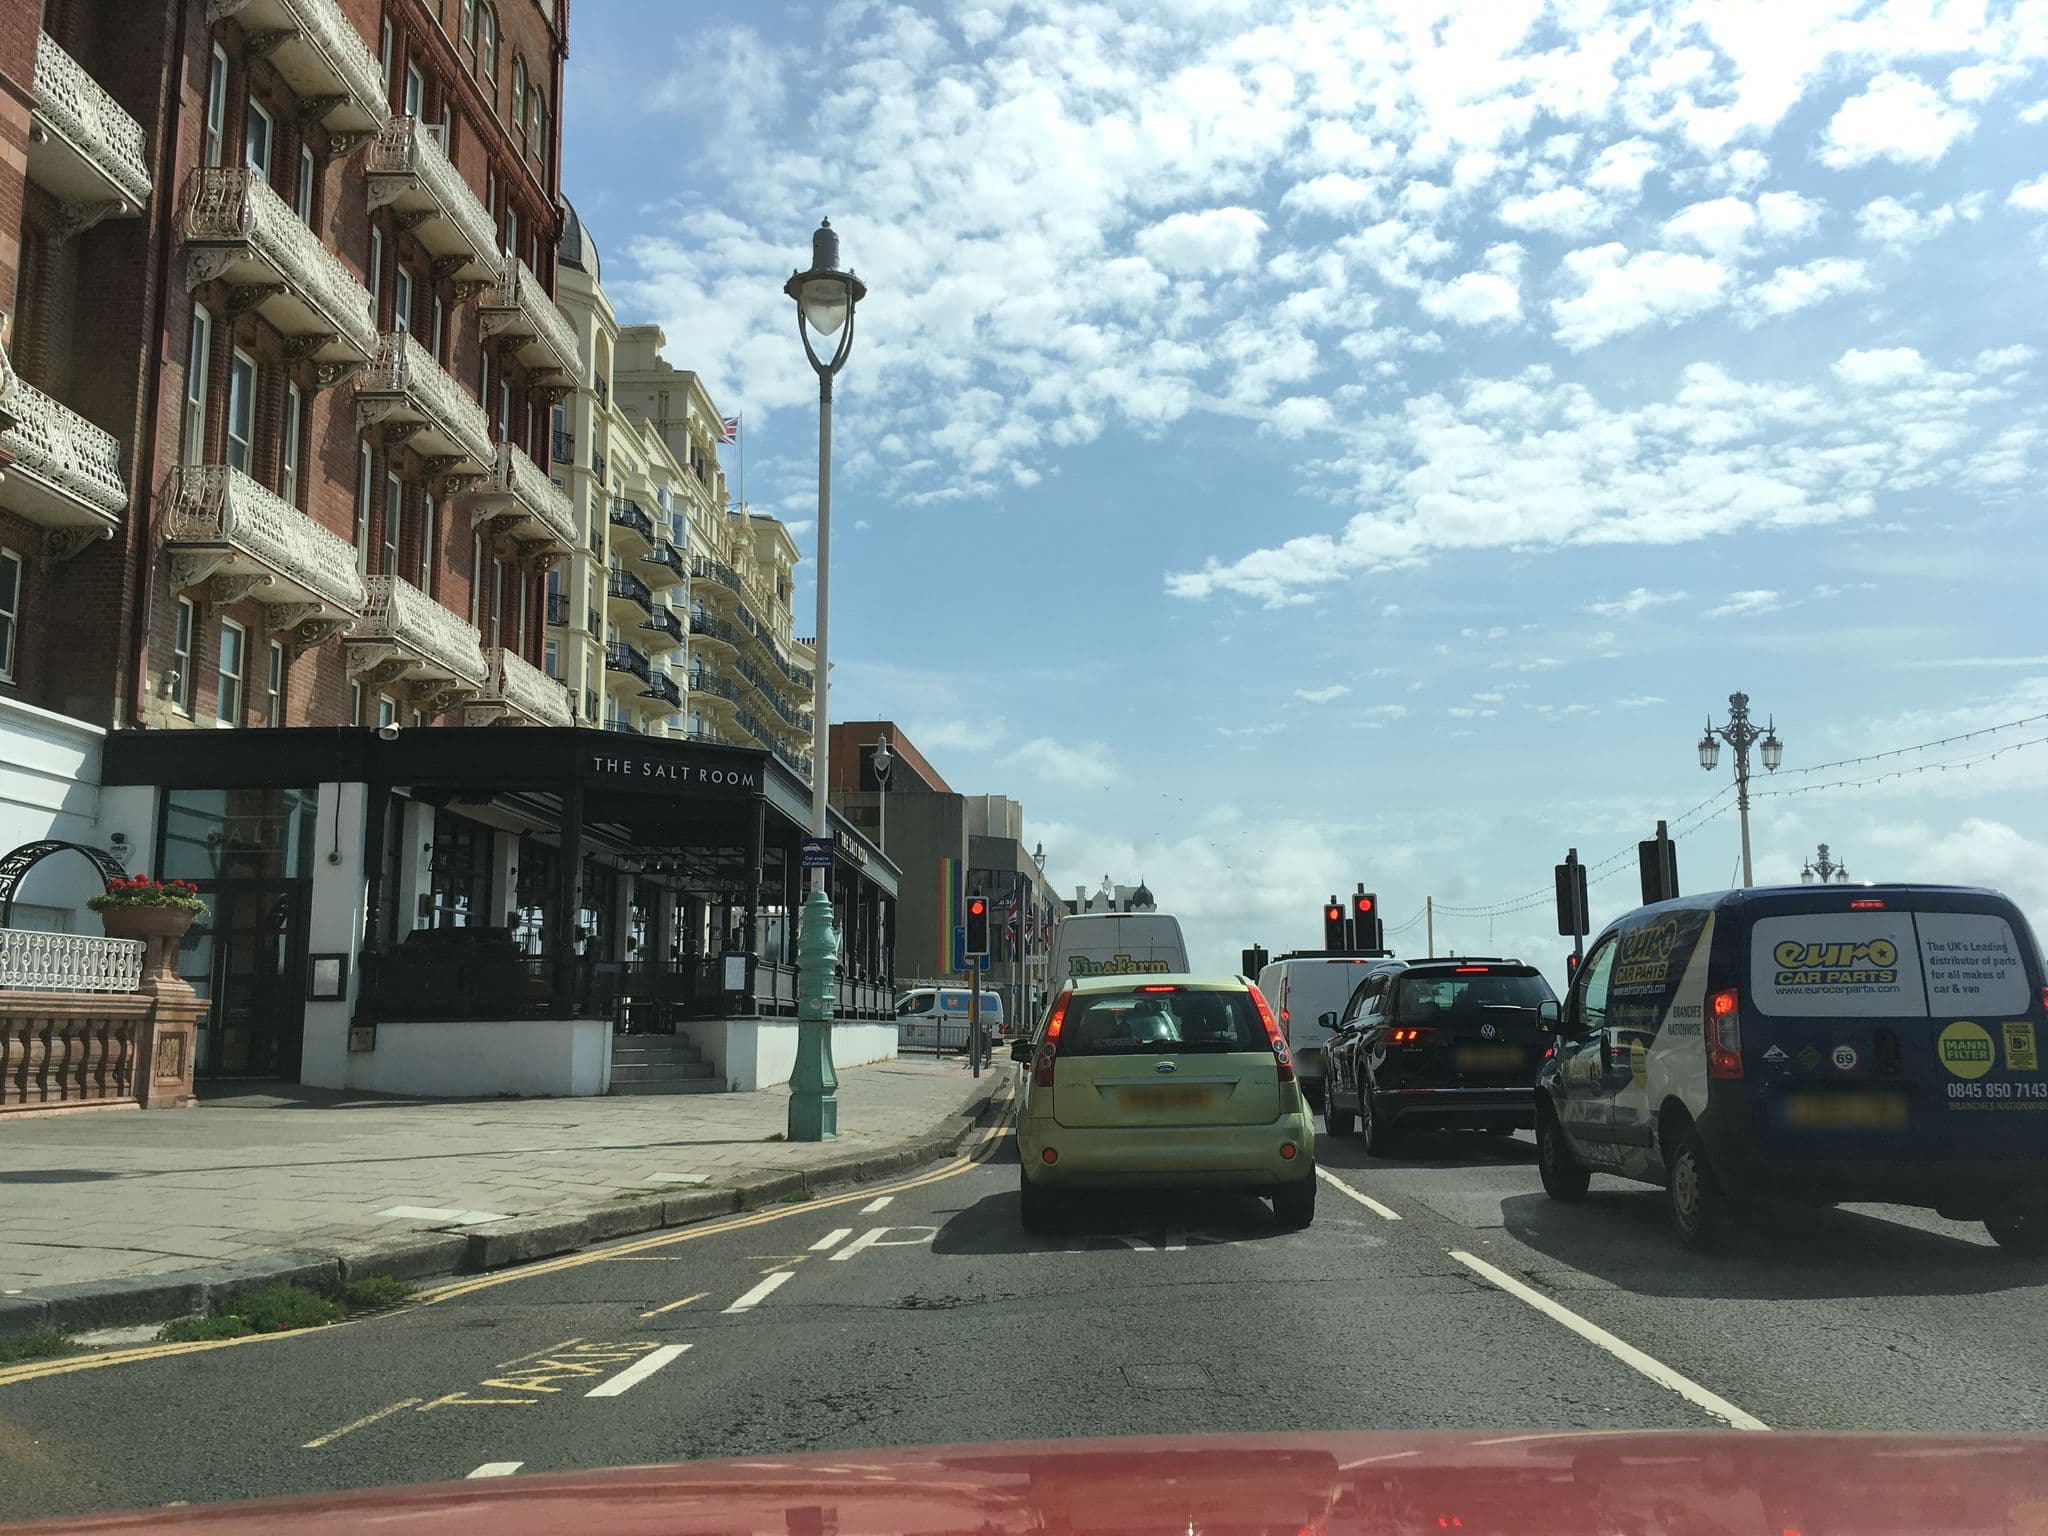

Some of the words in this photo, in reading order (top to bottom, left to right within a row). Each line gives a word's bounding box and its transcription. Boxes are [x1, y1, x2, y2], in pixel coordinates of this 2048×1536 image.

[594, 757, 631, 774] THE
[643, 763, 690, 780] SALT
[700, 769, 754, 787] ROOM
[1621, 919, 1677, 964] euro
[1927, 942, 1945, 951] The
[1947, 942, 1968, 951] UK's
[1970, 942, 2008, 953] Leading
[1774, 939, 1898, 969] euro
[1930, 956, 1979, 965] distributor
[1982, 956, 1991, 965] of
[1993, 957, 2016, 967] parts
[1616, 966, 1634, 981] CAR
[1634, 963, 1666, 980] PARTS
[1778, 971, 1821, 984] CAR
[1827, 970, 1893, 983] PARTS
[1931, 970, 1945, 979] for
[1947, 970, 1960, 979] all
[1963, 970, 1994, 979] makes
[1996, 970, 2005, 979] of
[1775, 985, 1900, 996] www.eurocarparts.com
[1934, 985, 1949, 993] car
[1952, 983, 1960, 993] &
[1963, 985, 1980, 993] van
[1673, 1006, 1702, 1018] BRANCHES
[1668, 1023, 1702, 1036] NATIONWIDE
[1946, 1040, 1988, 1049] MANN
[1836, 1053, 1853, 1064] 69
[1947, 1050, 1988, 1060] FILTER
[1947, 1083, 1982, 1098] 0845
[1985, 1083, 2011, 1098] 850
[2014, 1083, 2048, 1098] 7143
[417, 1339, 662, 1412] TAXIS
